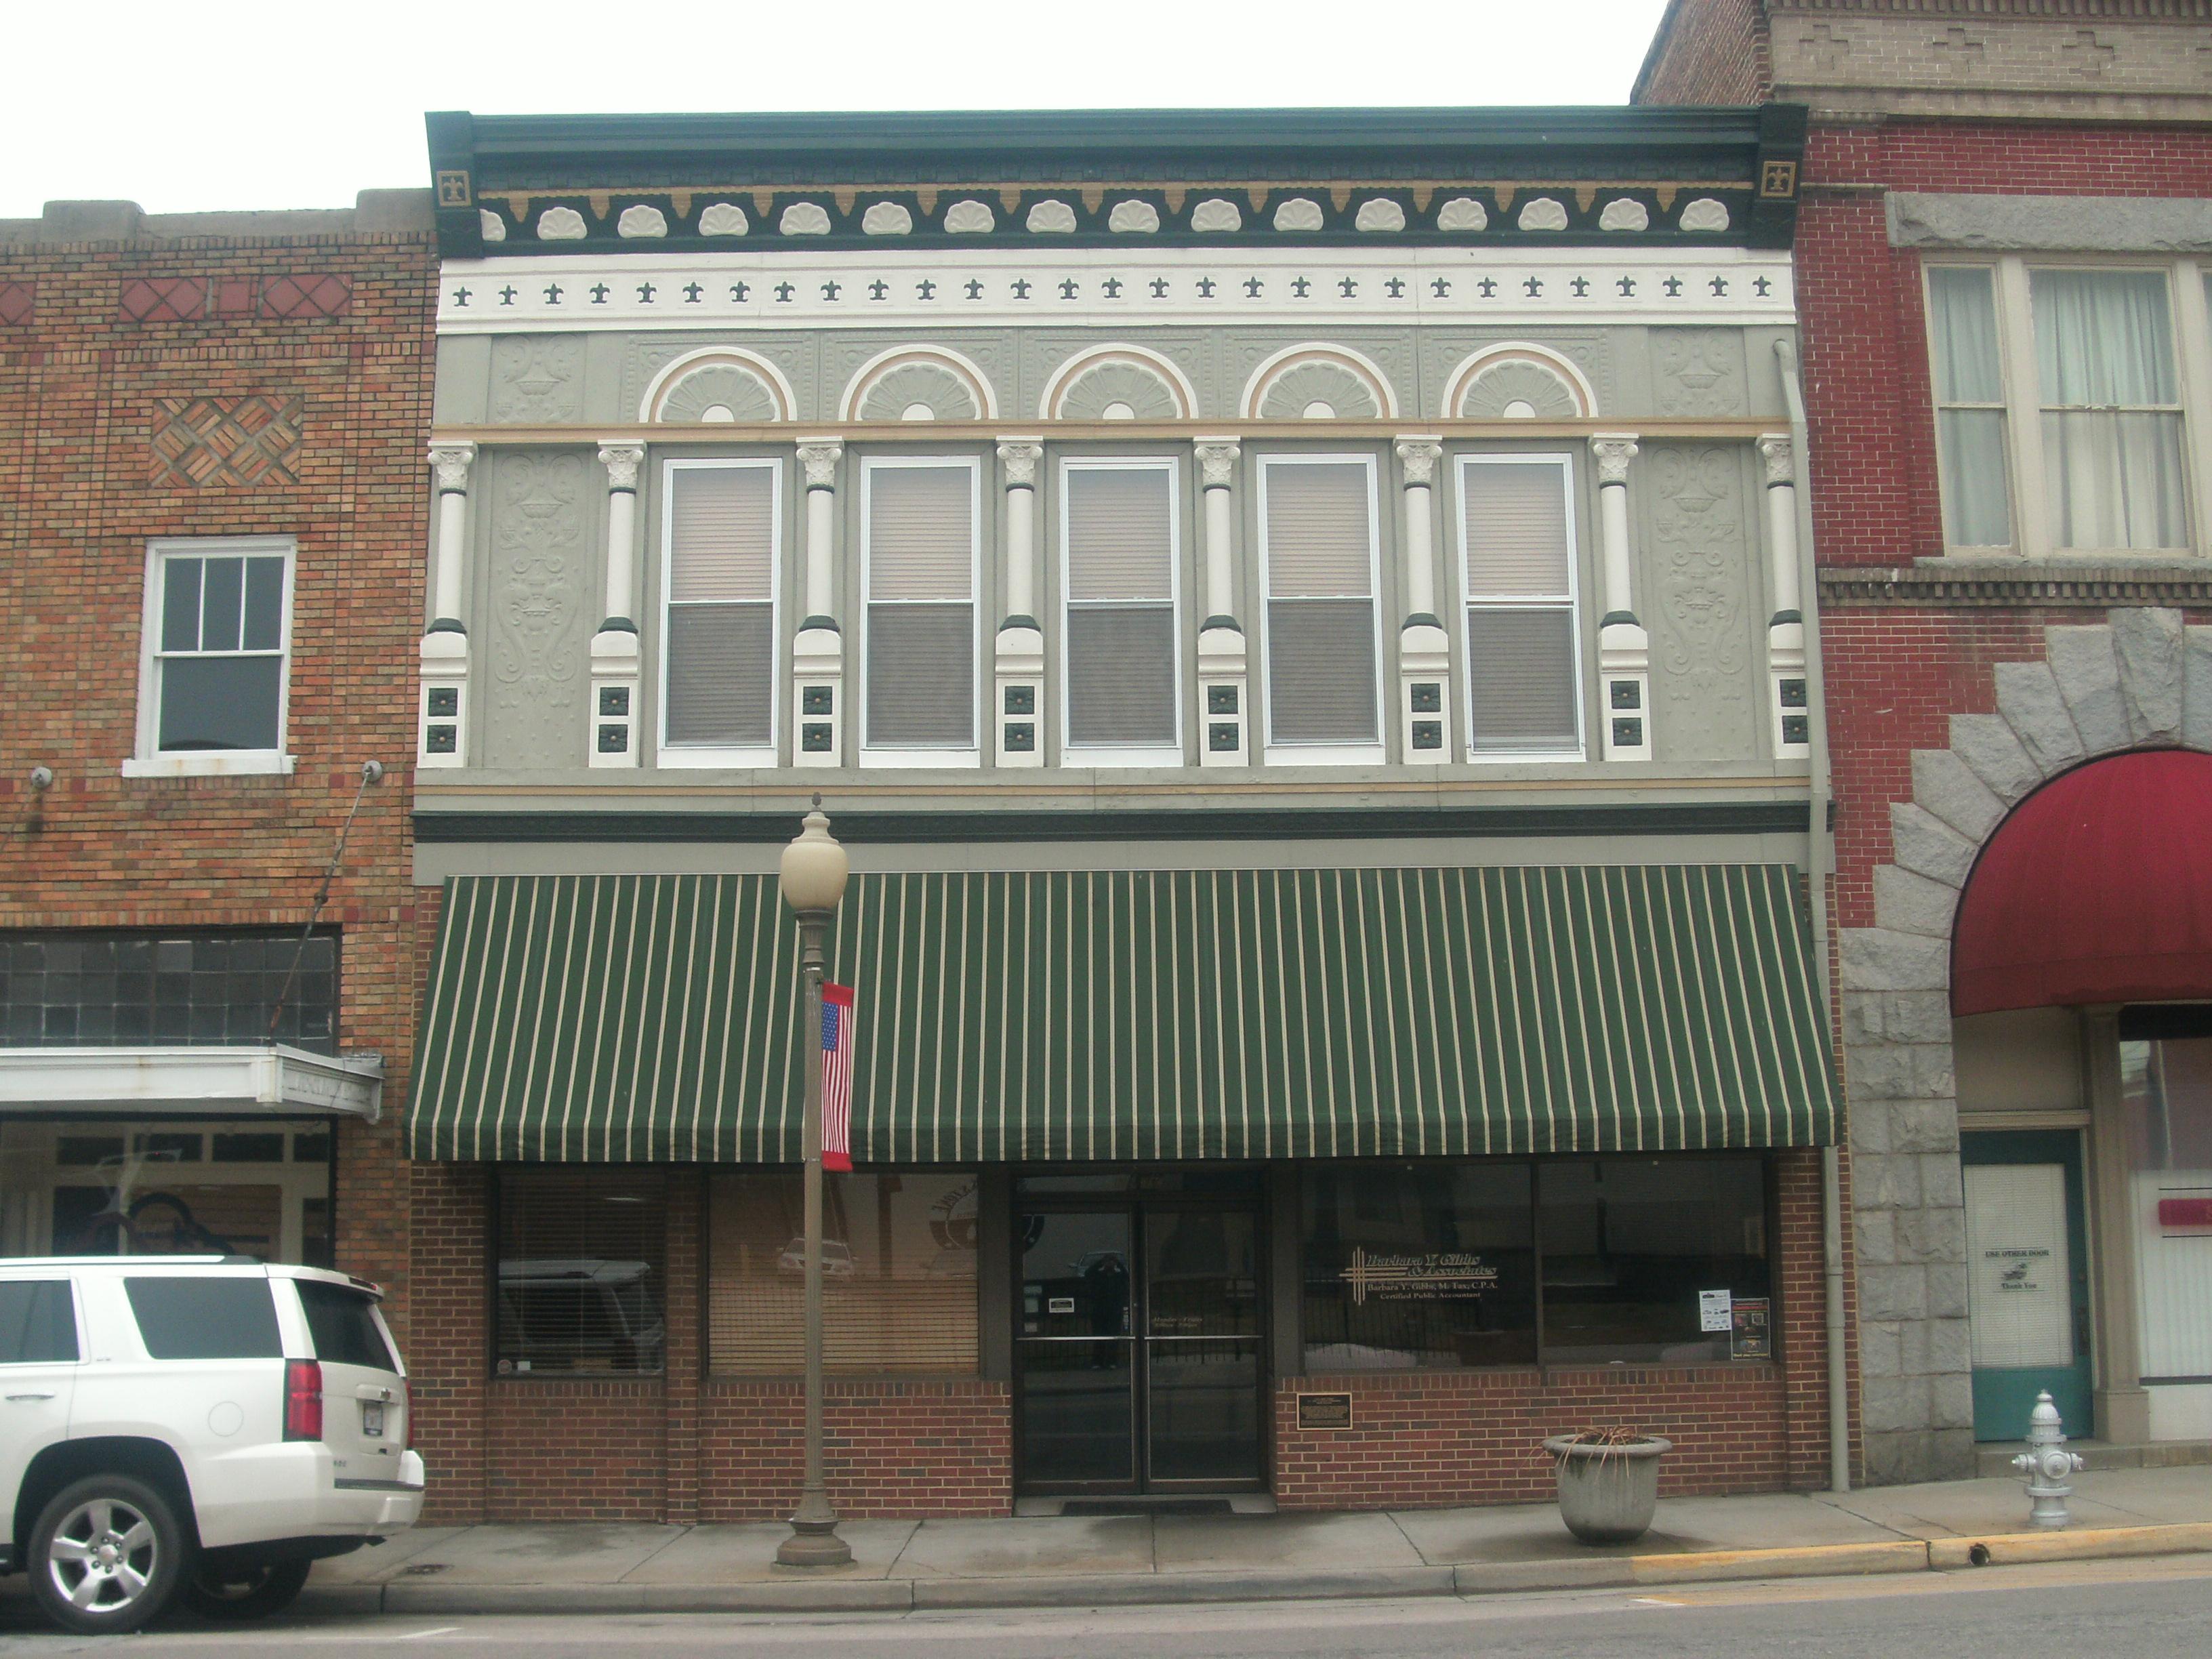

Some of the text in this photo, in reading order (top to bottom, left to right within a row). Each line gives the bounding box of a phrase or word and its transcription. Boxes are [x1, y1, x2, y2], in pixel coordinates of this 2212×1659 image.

[1365, 1254, 1422, 1266] Barbara
[1439, 1253, 1480, 1266] Gibbs
[1408, 1266, 1421, 1277] &
[1412, 1282, 1437, 1290] Gibbs,
[1471, 1281, 1498, 1289] C.P.A.
